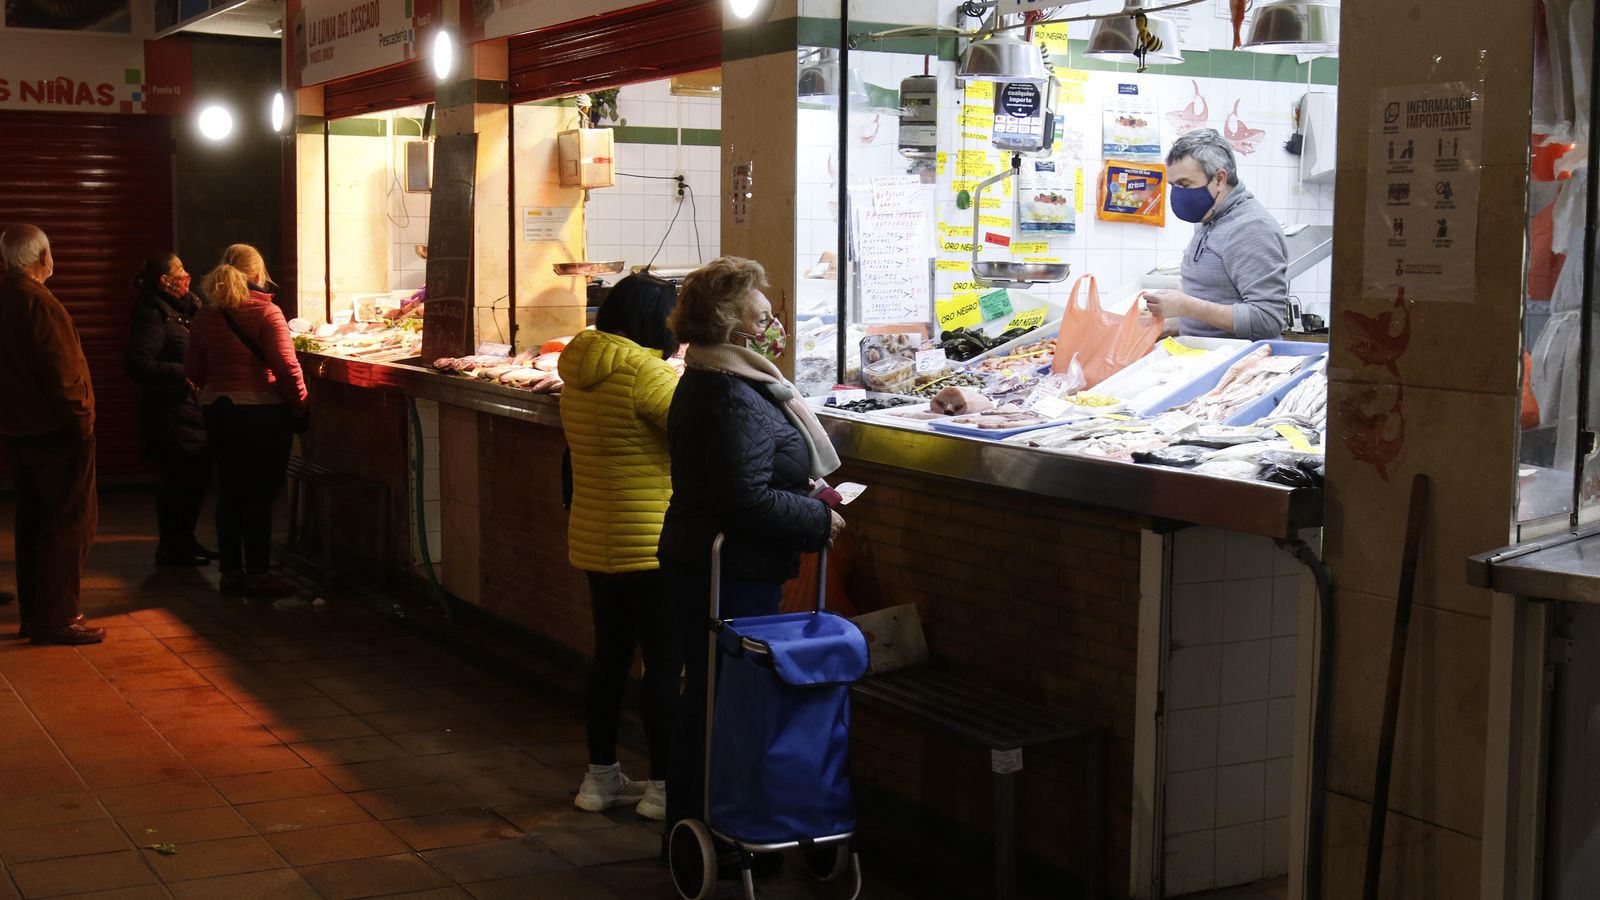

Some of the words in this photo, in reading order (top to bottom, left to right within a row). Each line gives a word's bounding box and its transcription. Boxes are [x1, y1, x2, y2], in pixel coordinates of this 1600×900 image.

[309, 23, 317, 47] LA
[318, 16, 336, 45] LONJA
[337, 11, 349, 39] DEL
[350, 0, 380, 35] PESCADO
[378, 27, 408, 48] Pescadería
[1034, 31, 1045, 39] RO
[1046, 32, 1068, 41] NEGRO
[20, 76, 116, 106] NIÑAS
[152, 85, 172, 95] Puesto
[172, 85, 181, 95] 12
[1008, 96, 1033, 104] importe
[1406, 94, 1472, 114] INFORMACIÓN
[1406, 111, 1472, 129] IMPORTANTE
[944, 242, 959, 250] ORO
[961, 243, 983, 252] NEGO
[953, 282, 968, 290] ORO
[940, 312, 955, 324] ORO
[956, 302, 978, 317] NEGRO
[1008, 319, 1023, 327] ORO
